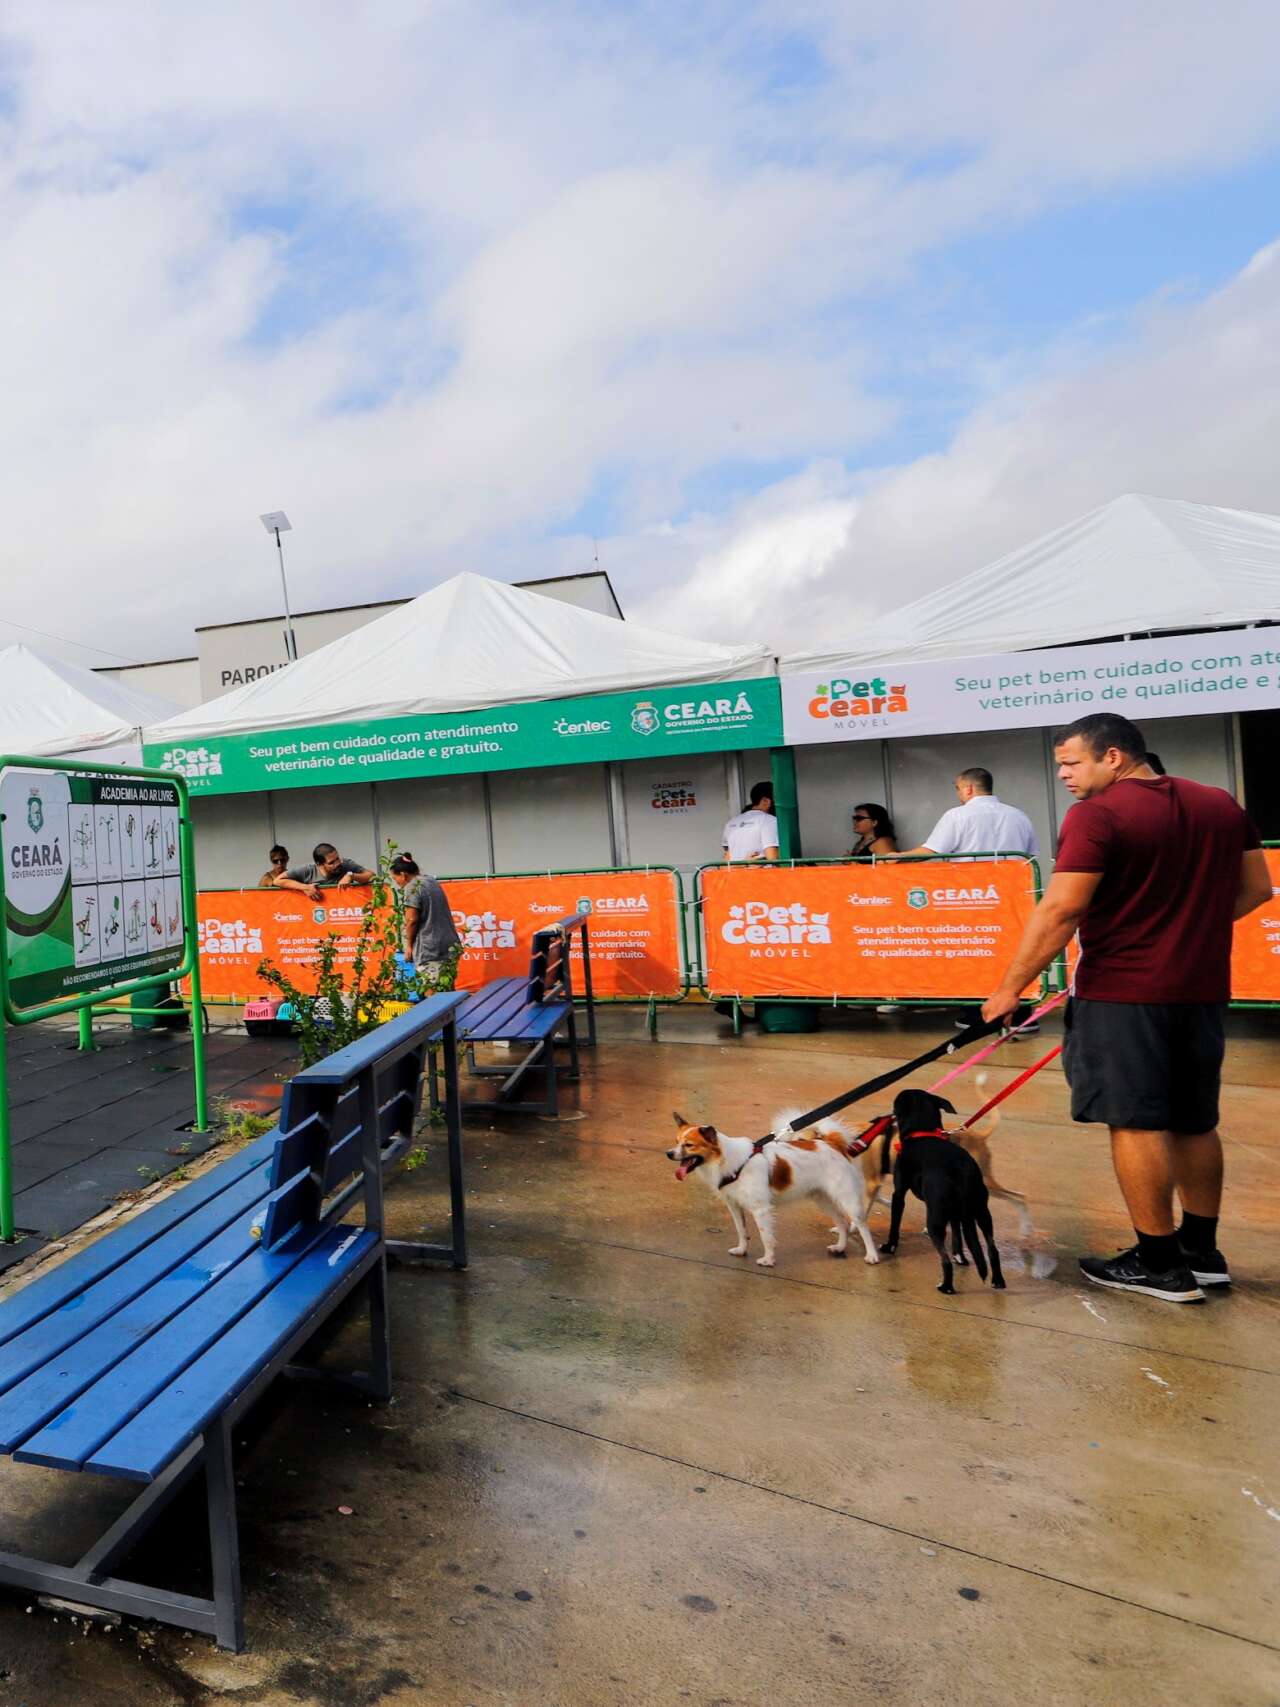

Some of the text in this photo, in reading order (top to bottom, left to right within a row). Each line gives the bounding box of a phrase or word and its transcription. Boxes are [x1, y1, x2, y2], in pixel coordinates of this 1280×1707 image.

[221, 663, 289, 686] PARQ
[955, 677, 991, 692] Seu
[999, 672, 1033, 690] pet
[1039, 668, 1087, 685] bem
[1094, 658, 1184, 679] cuidado
[1191, 655, 1242, 671] com
[830, 677, 887, 700] Pet
[979, 675, 1270, 710] veterinário de qualidade e
[664, 691, 753, 720] CEARÁ
[665, 714, 754, 728] GOVERNO DO ESTADO
[833, 718, 889, 729] MÓVEL
[249, 721, 519, 759] Seu pet bem cuidado com atendimento
[172, 747, 209, 765] Pet
[265, 741, 503, 773] veterinário de qualidade e gratuito.
[100, 786, 174, 802] ACADEMIA AO AR LIVRE
[11, 837, 63, 868] CEARÁ
[12, 869, 37, 879] GOVERNO
[45, 867, 64, 877] ESTADO
[932, 884, 1000, 900] CEARÁ
[596, 894, 649, 909] CEARÁ
[329, 907, 372, 917] CEAR
[745, 901, 807, 925] Pet
[205, 919, 247, 938] Pet
[629, 930, 651, 938] com
[853, 924, 1002, 935] Seu pet bem cuidado com
[857, 935, 996, 945] atendimento veterinário
[462, 951, 500, 960] ÓVEL
[750, 946, 811, 958] MÓVEL
[861, 948, 995, 959] de qualidade e gratuito.
[208, 957, 250, 965] MÓVEL
